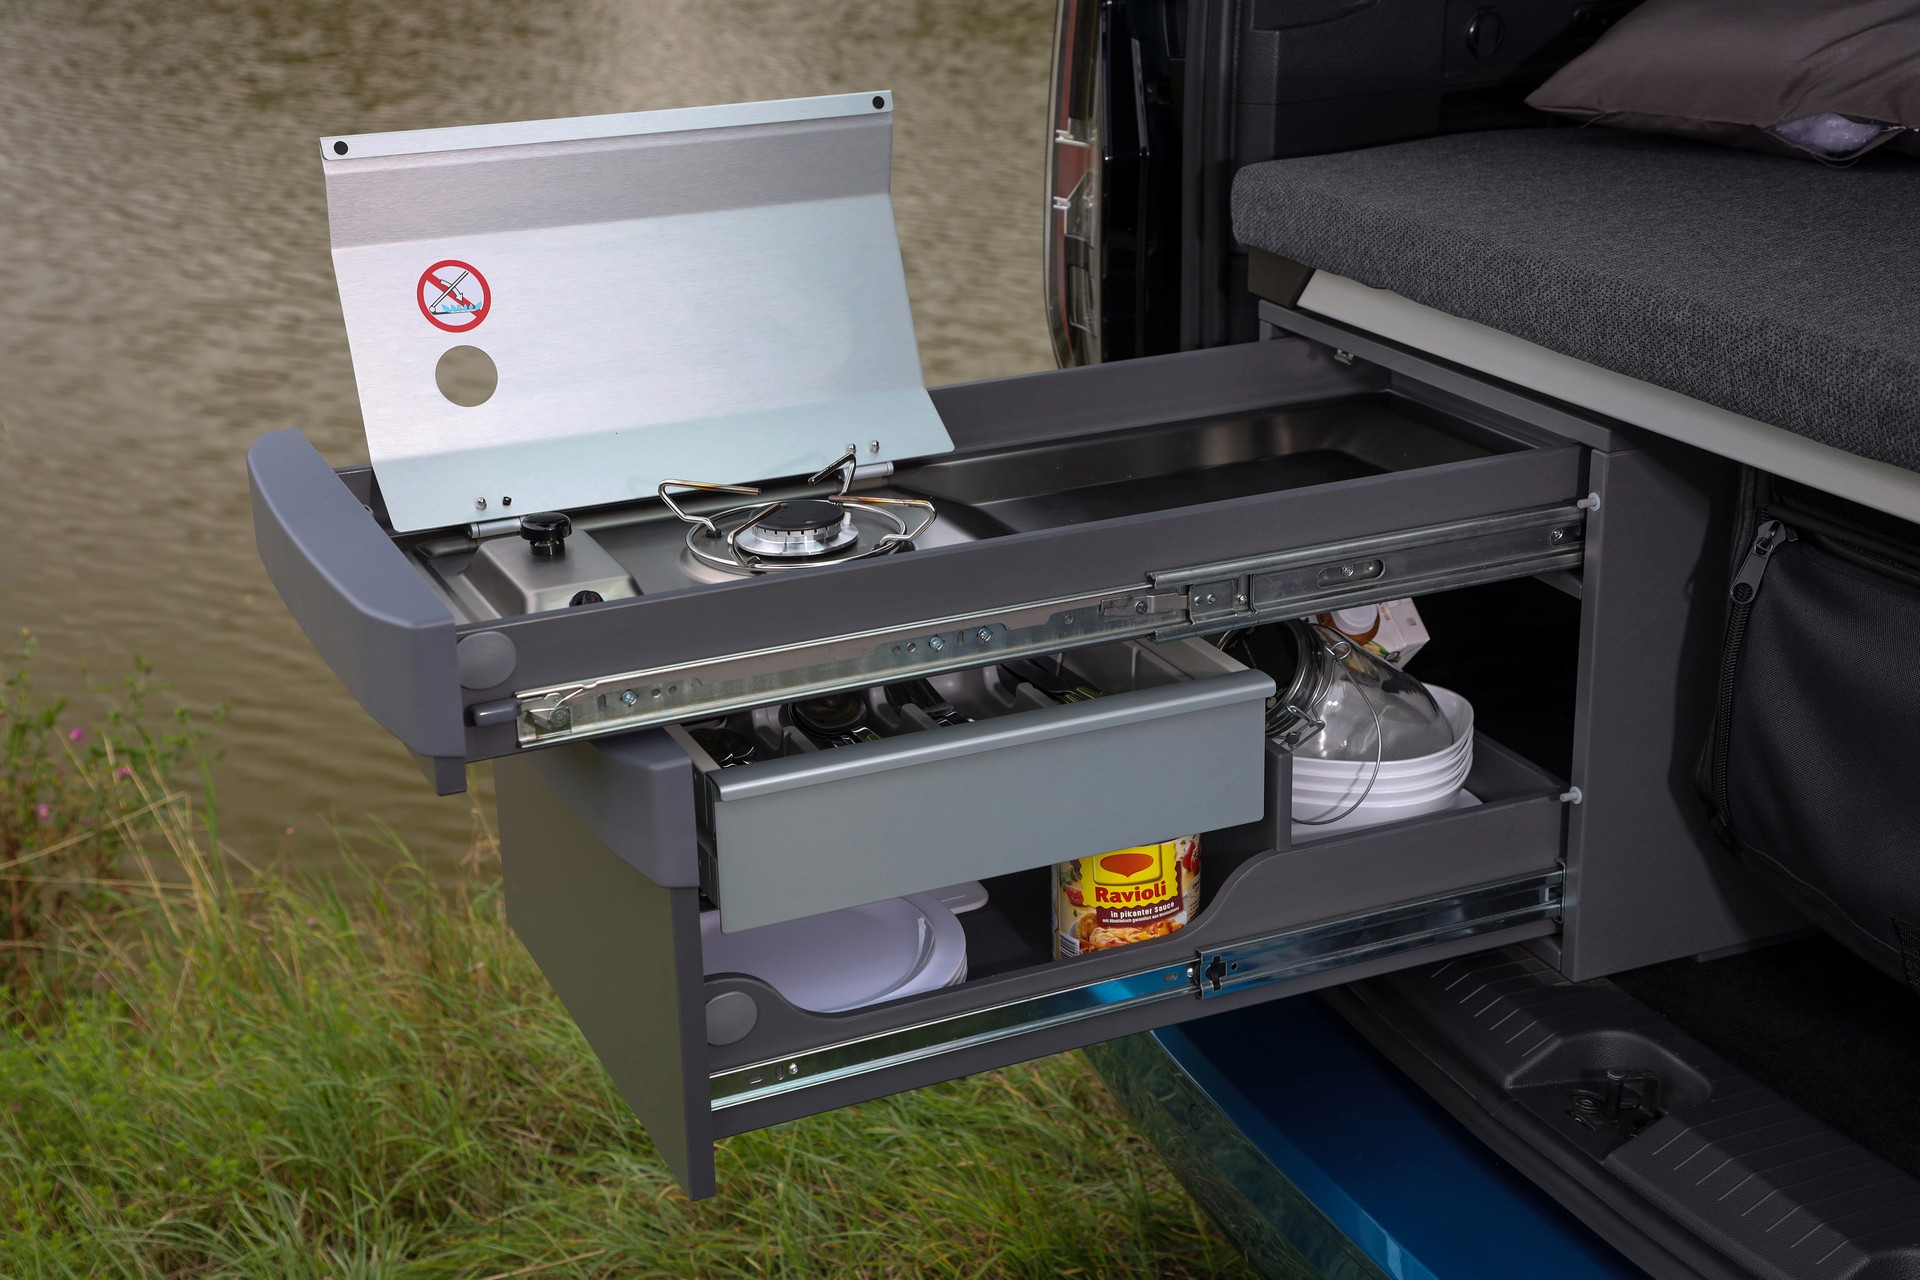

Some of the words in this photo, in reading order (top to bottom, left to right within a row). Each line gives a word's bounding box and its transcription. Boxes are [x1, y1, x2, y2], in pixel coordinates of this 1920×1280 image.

[1095, 880, 1167, 903] Ravioli
[1110, 910, 1119, 918] in
[1120, 908, 1153, 919] pikanter
